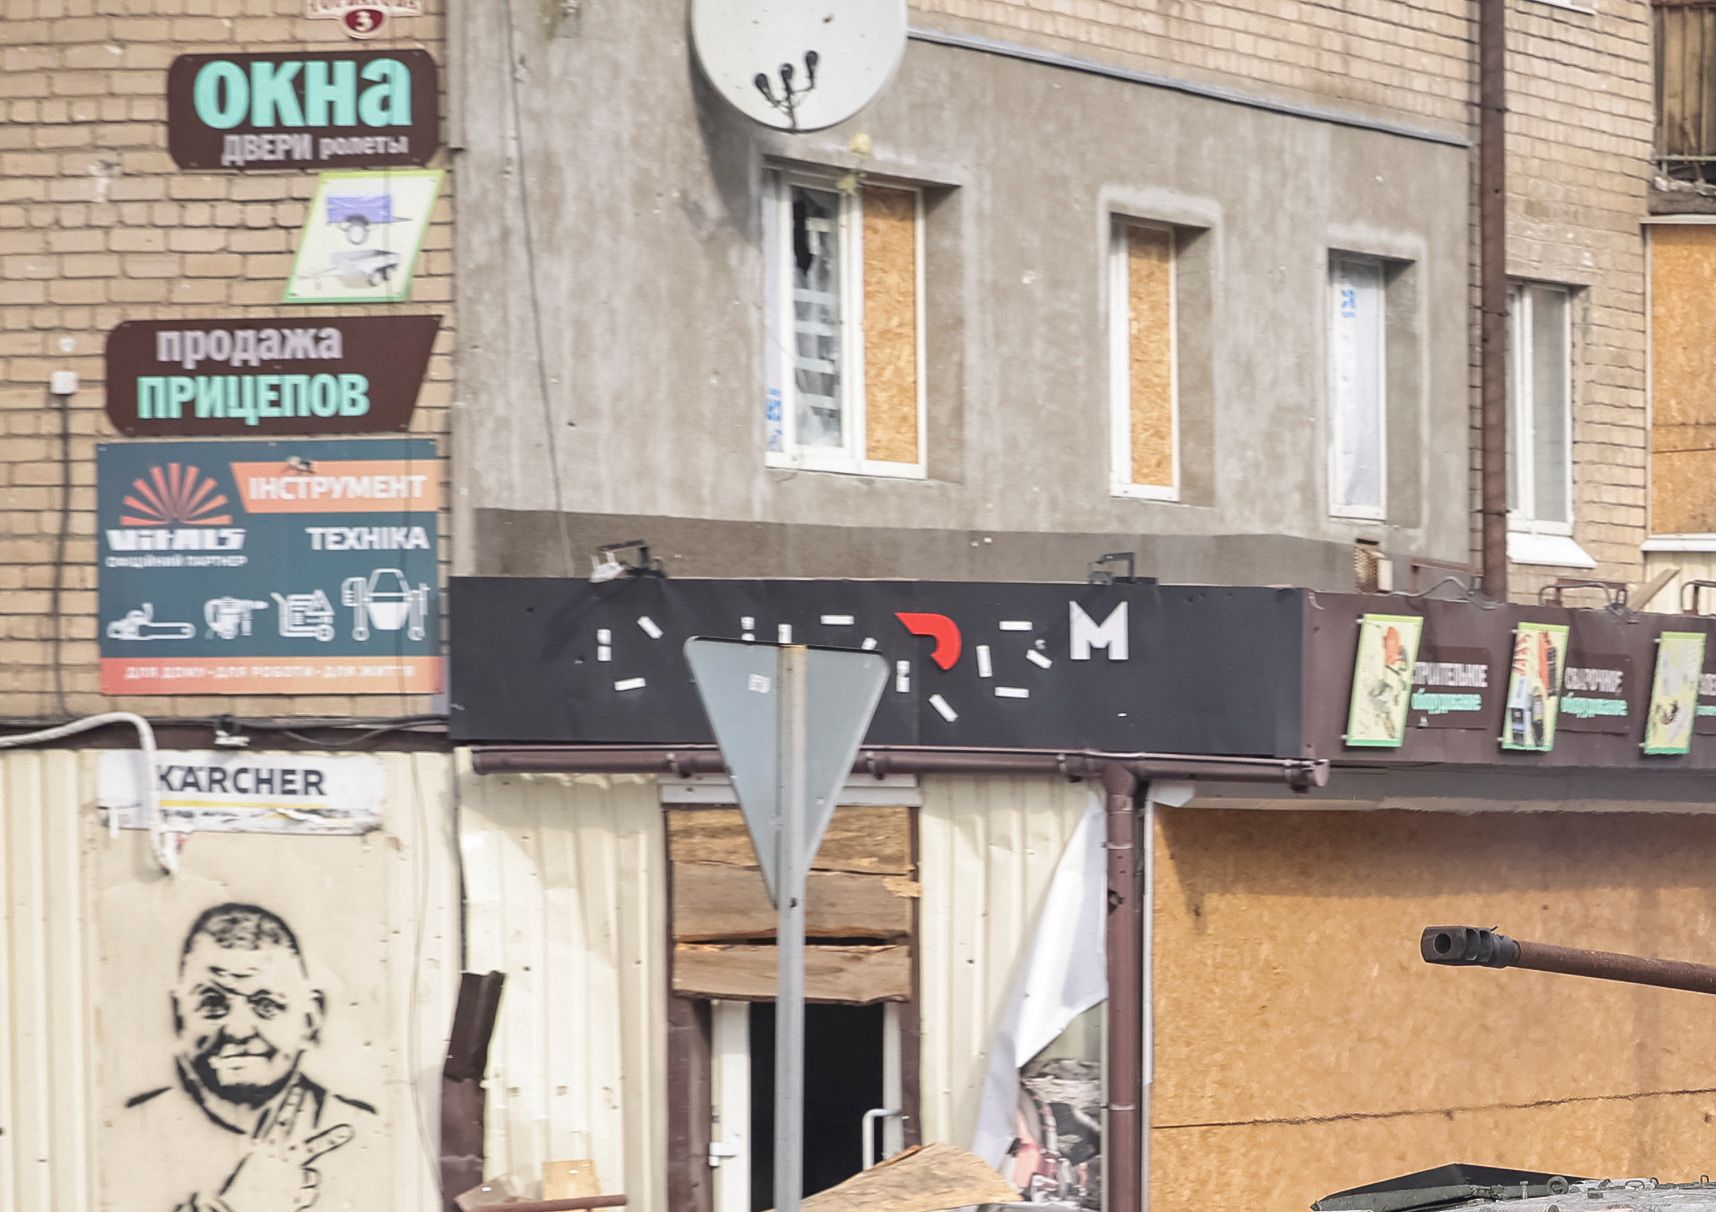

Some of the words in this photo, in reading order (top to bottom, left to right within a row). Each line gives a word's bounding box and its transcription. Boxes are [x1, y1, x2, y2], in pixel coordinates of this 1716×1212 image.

[354, 9, 375, 32] 3
[221, 133, 313, 166] ДВЕРИ
[319, 135, 410, 160] ролеты
[156, 326, 344, 370] продажа
[136, 373, 371, 426] ПРИЦЕПОВ
[248, 474, 428, 501] ІНСТРУМЕНТ
[305, 525, 431, 551] ТЕХНІКА
